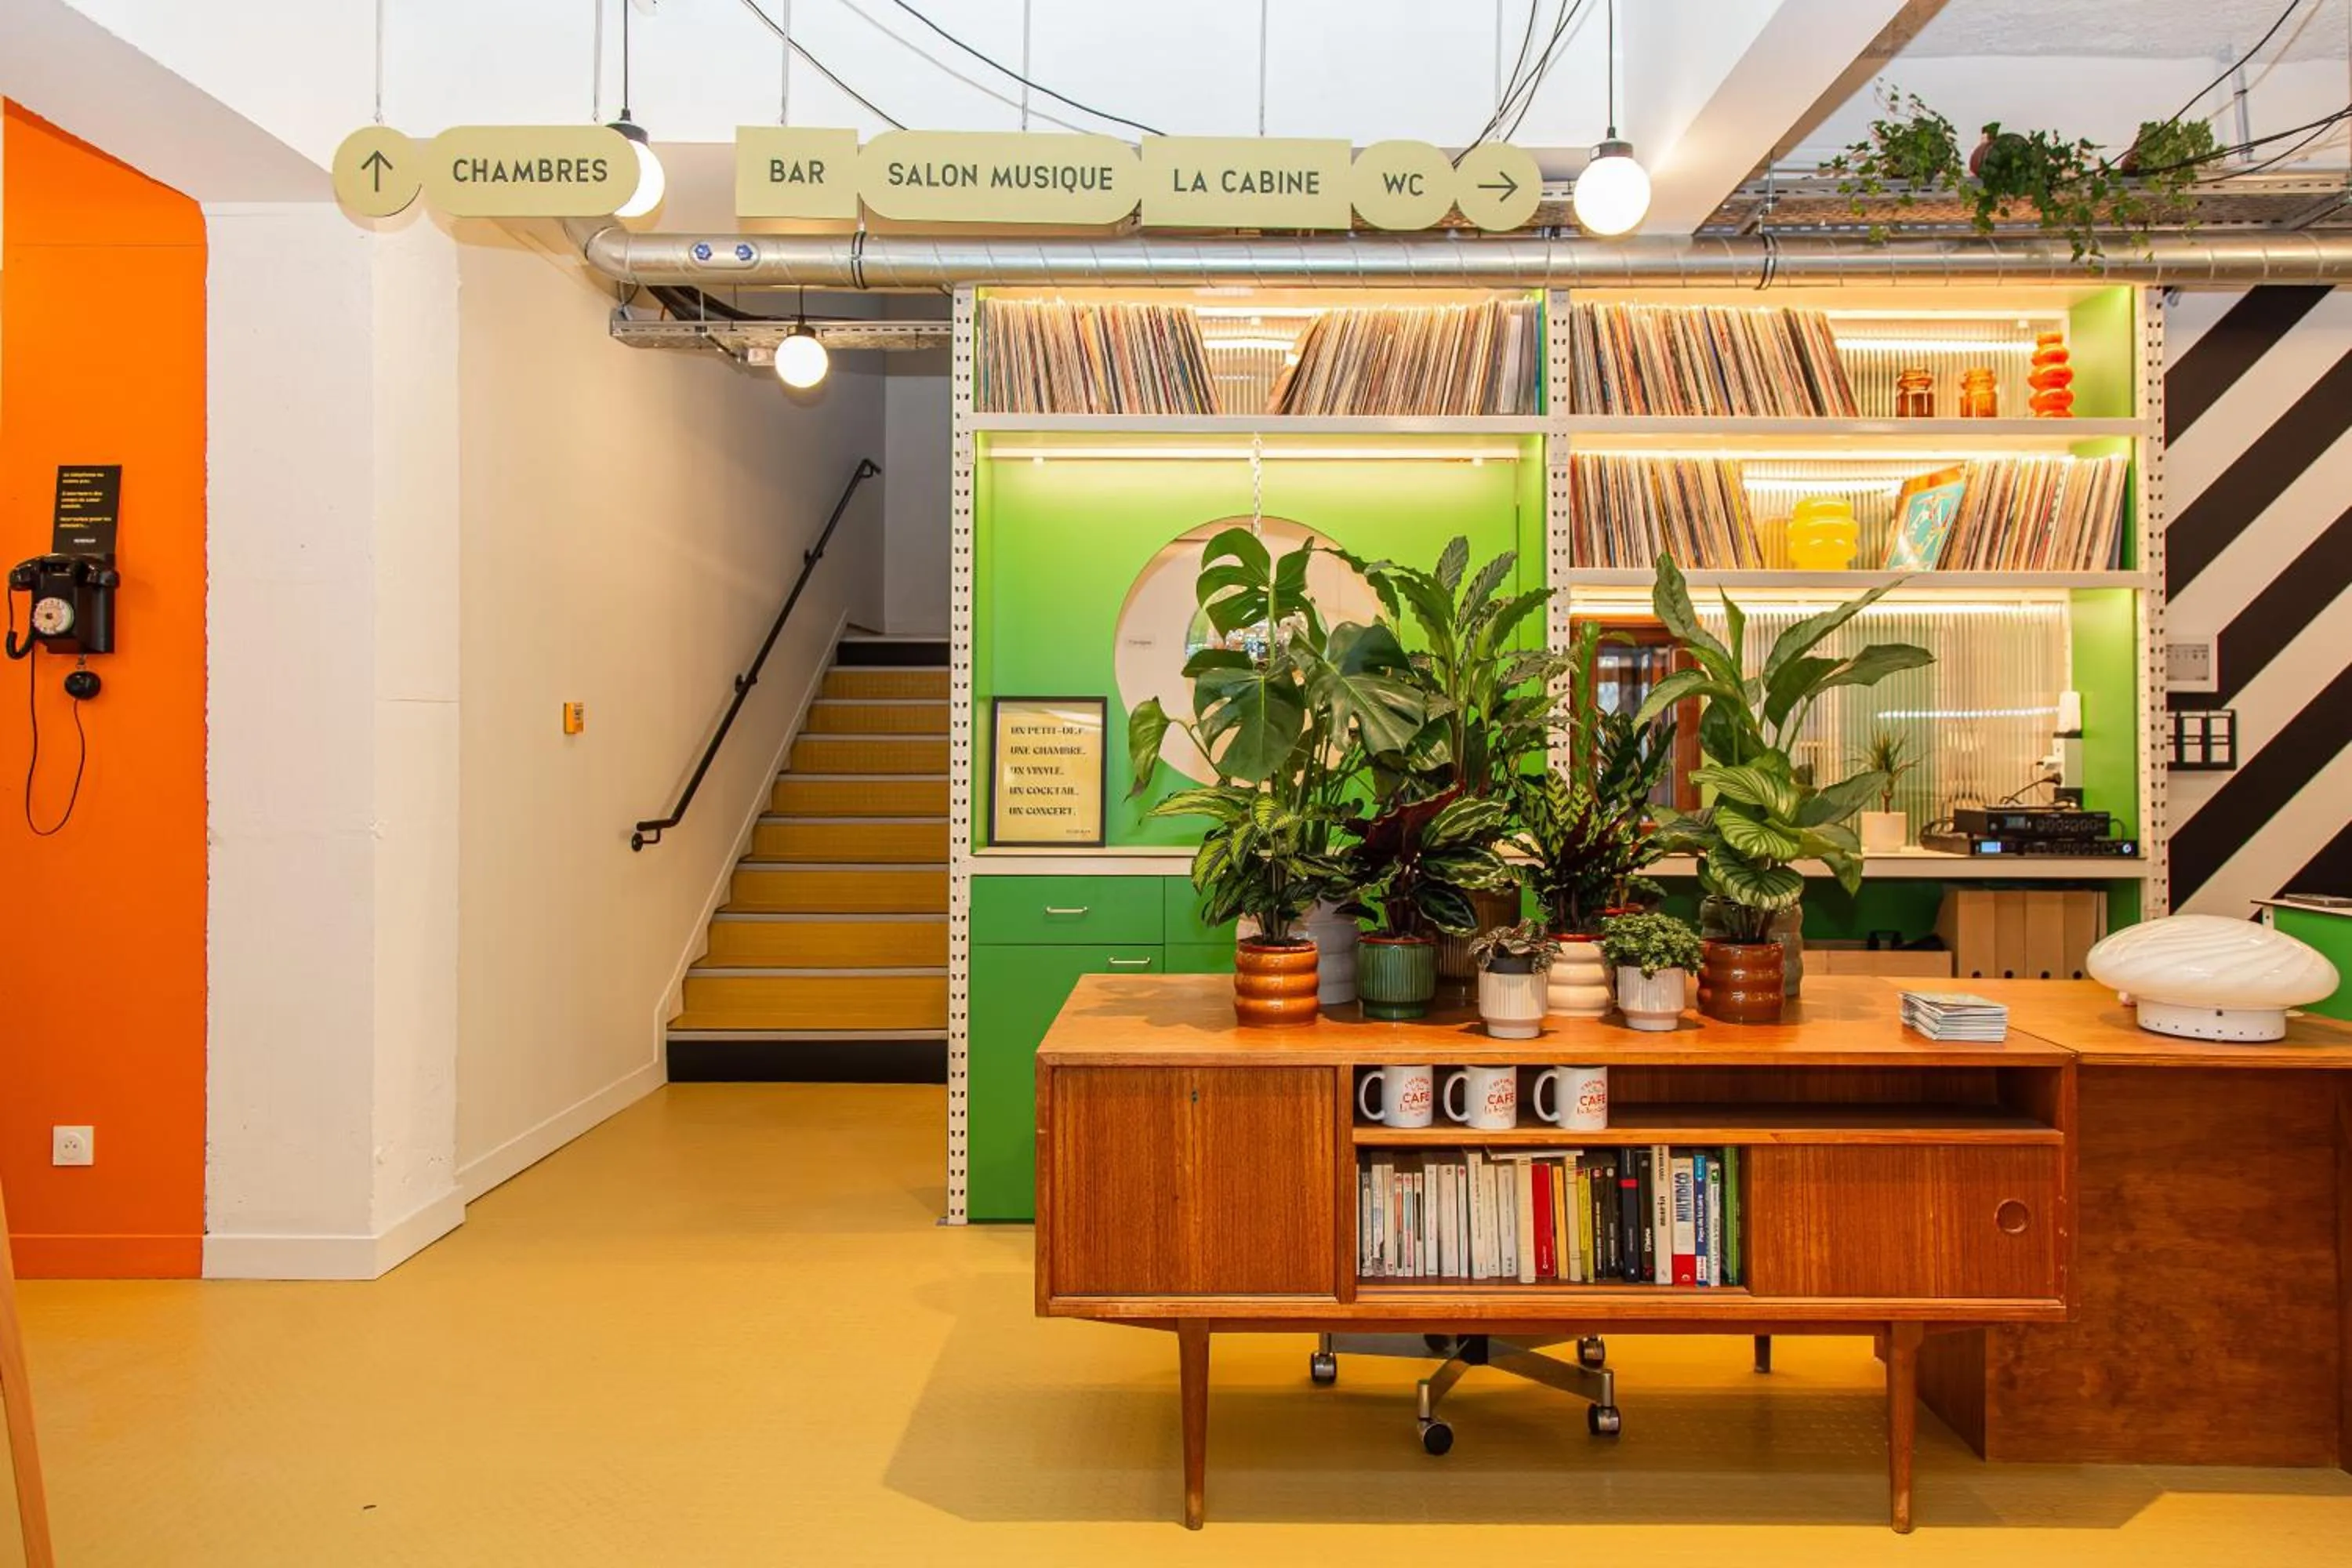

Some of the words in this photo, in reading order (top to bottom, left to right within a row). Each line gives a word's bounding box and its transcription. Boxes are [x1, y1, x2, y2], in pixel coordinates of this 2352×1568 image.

[452, 158, 608, 183] CHAMBRES
[769, 159, 826, 184] BAR
[887, 162, 978, 188] SALON
[991, 165, 1112, 192] MUSIQUE
[1174, 168, 1208, 194] LA
[1221, 170, 1320, 195] CABINE
[1382, 172, 1425, 196] WC
[1674, 1172, 1693, 1221] MULTIDICO
